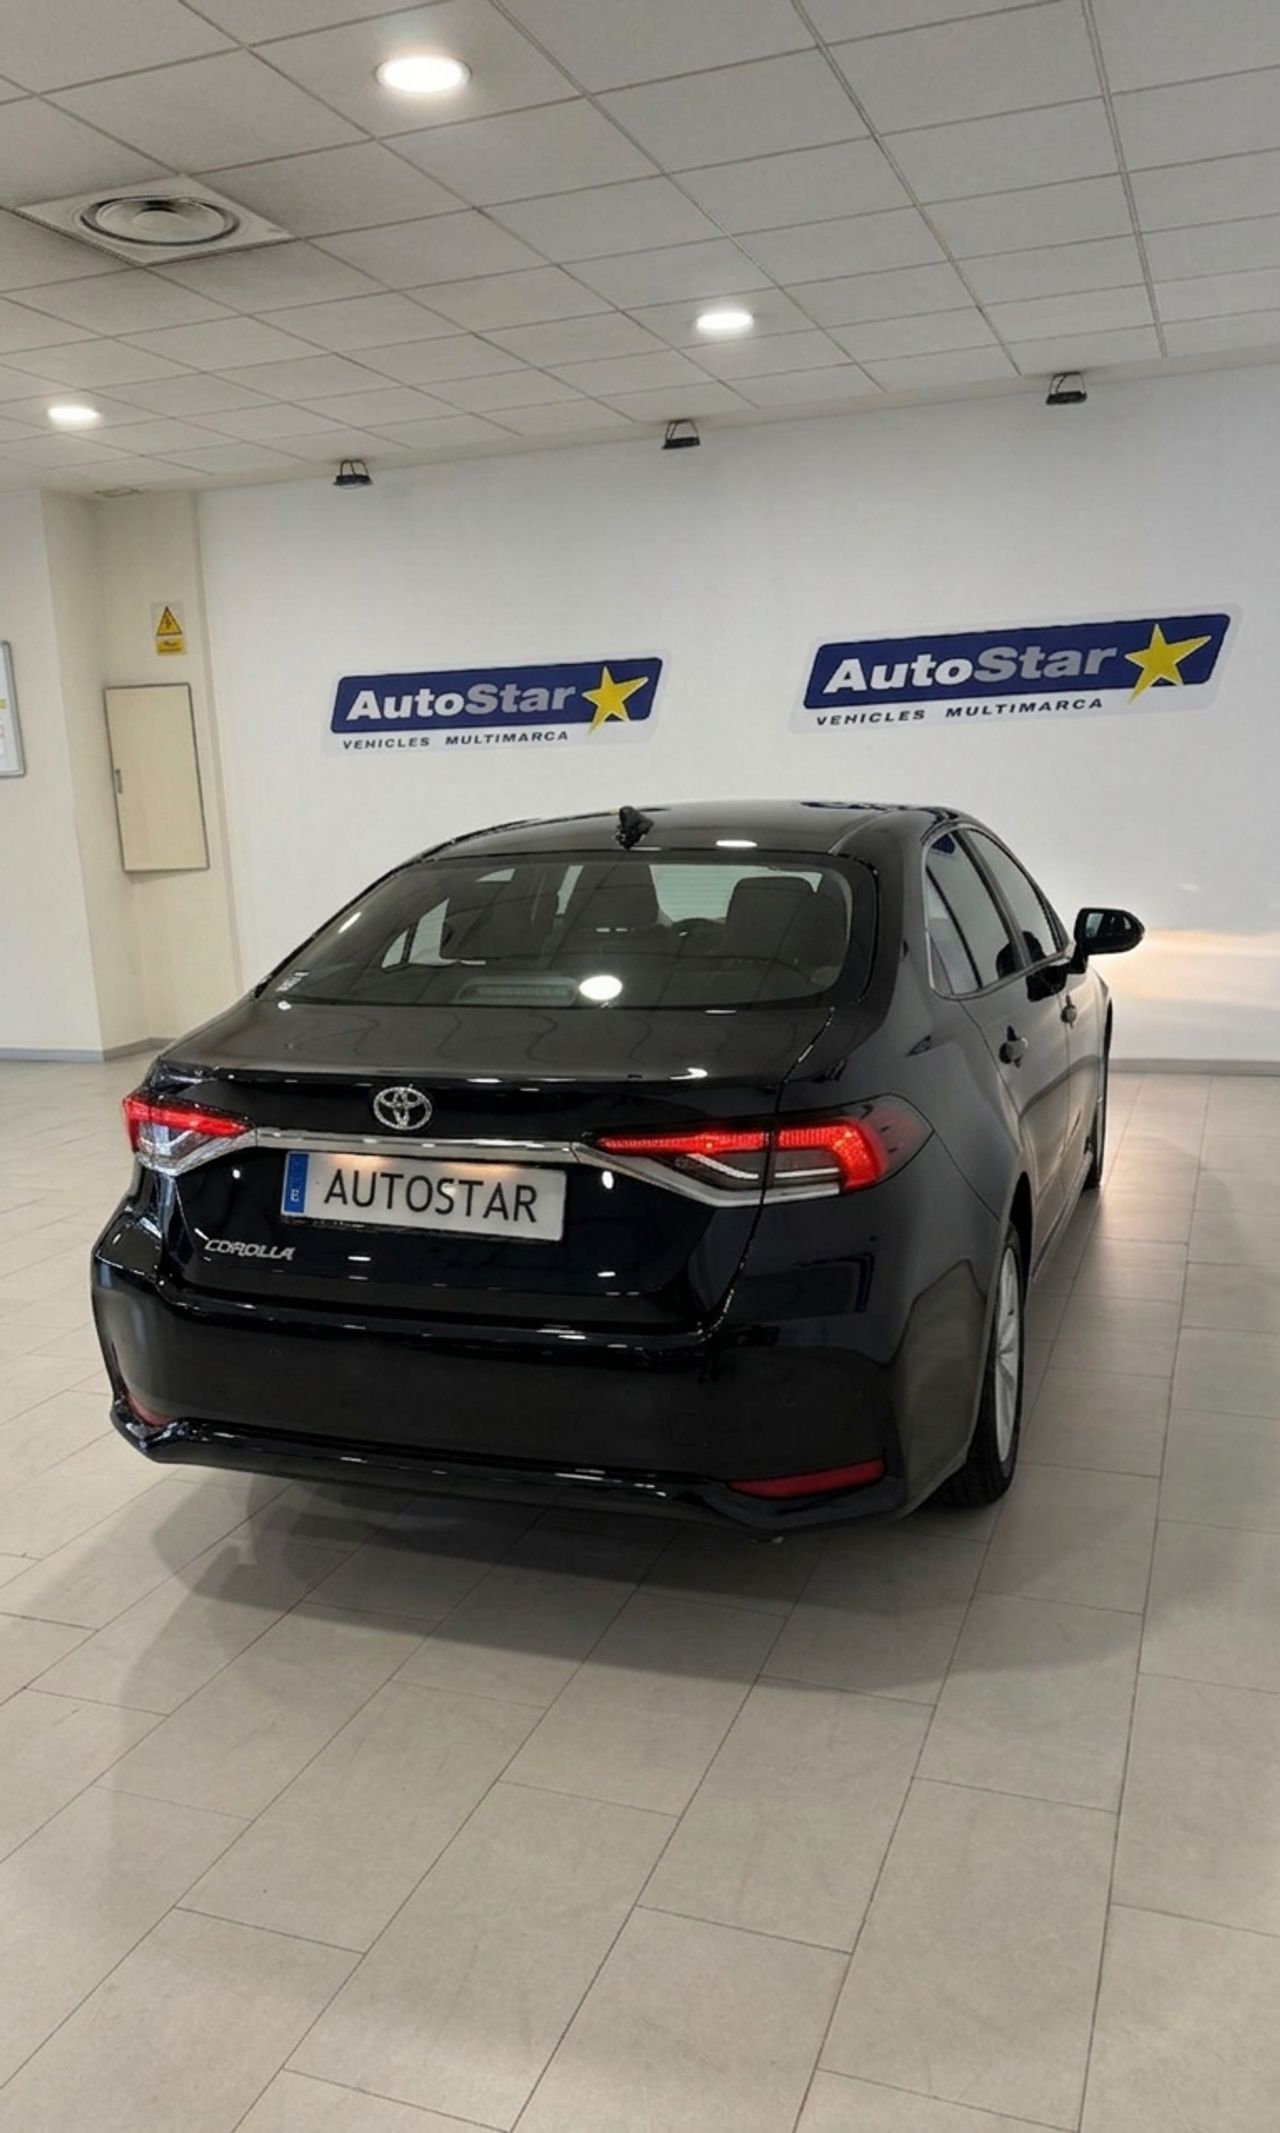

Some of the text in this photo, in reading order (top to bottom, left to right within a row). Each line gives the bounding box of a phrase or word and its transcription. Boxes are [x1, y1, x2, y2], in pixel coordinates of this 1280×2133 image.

[822, 645, 1118, 694] AutoStar
[346, 683, 576, 721] AutoStar
[945, 698, 1103, 718] MULTIMARCA
[445, 730, 569, 745] MULTIMARCA
[324, 1169, 538, 1223] AUTOSTAR
[204, 1238, 297, 1261] COROLLA
